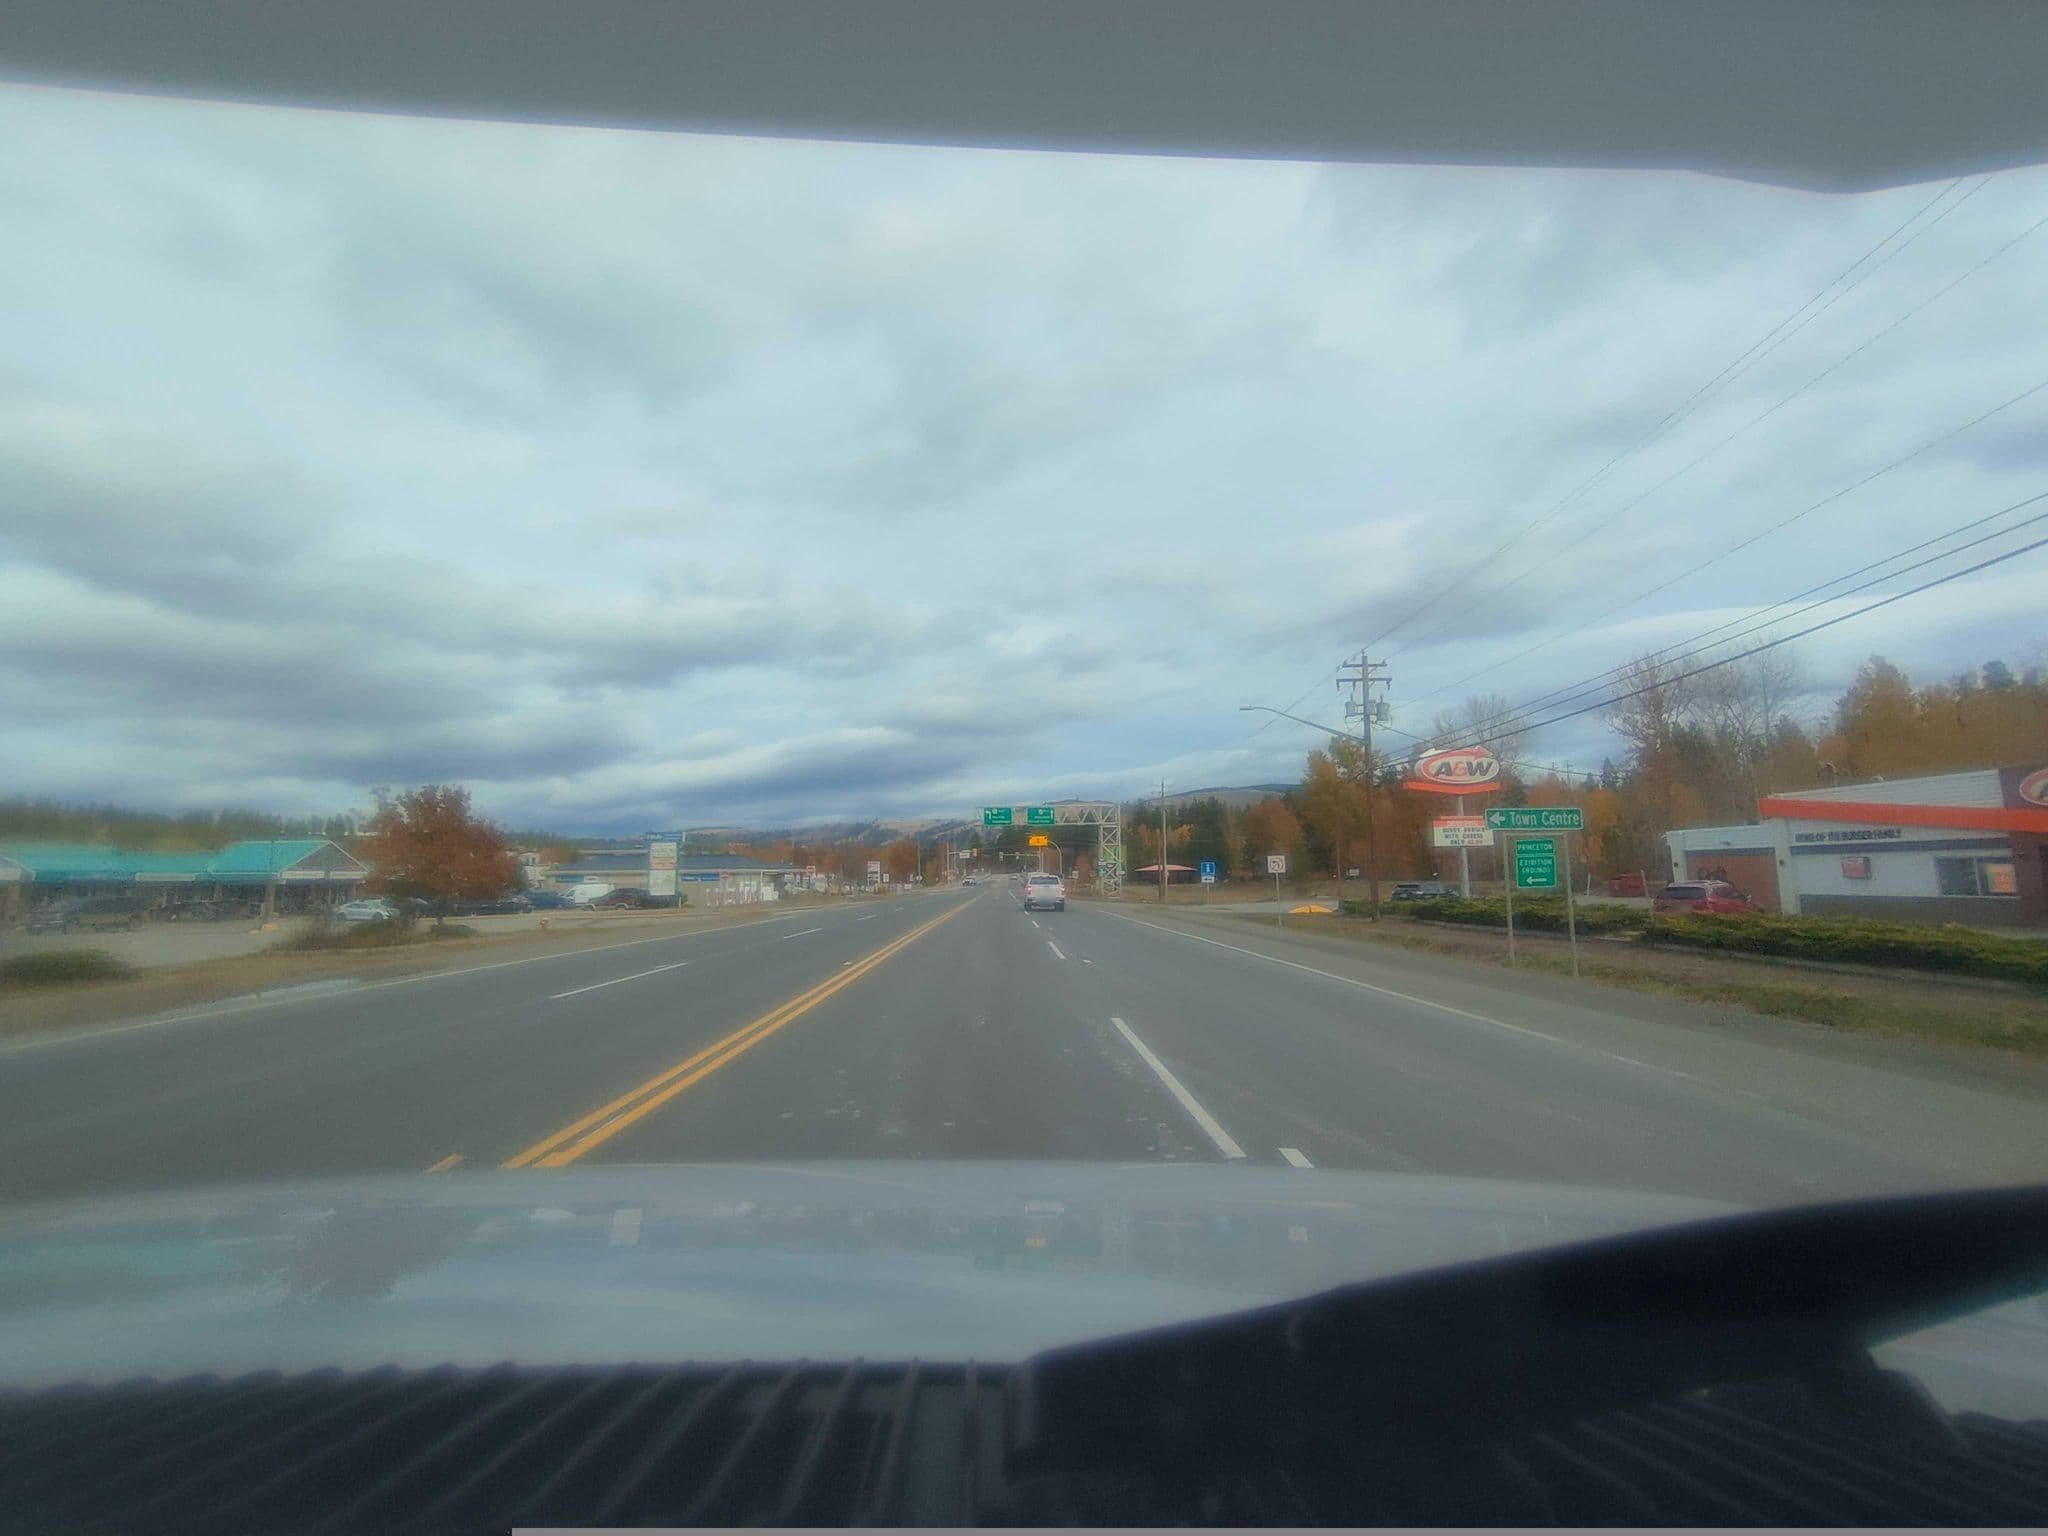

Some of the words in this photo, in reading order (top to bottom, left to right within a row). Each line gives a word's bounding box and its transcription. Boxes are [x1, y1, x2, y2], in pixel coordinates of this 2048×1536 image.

[1433, 761, 1493, 777] A&W
[1508, 811, 1537, 826] Town
[1541, 810, 1580, 825] Centre
[1517, 842, 1553, 850] PRINCETON
